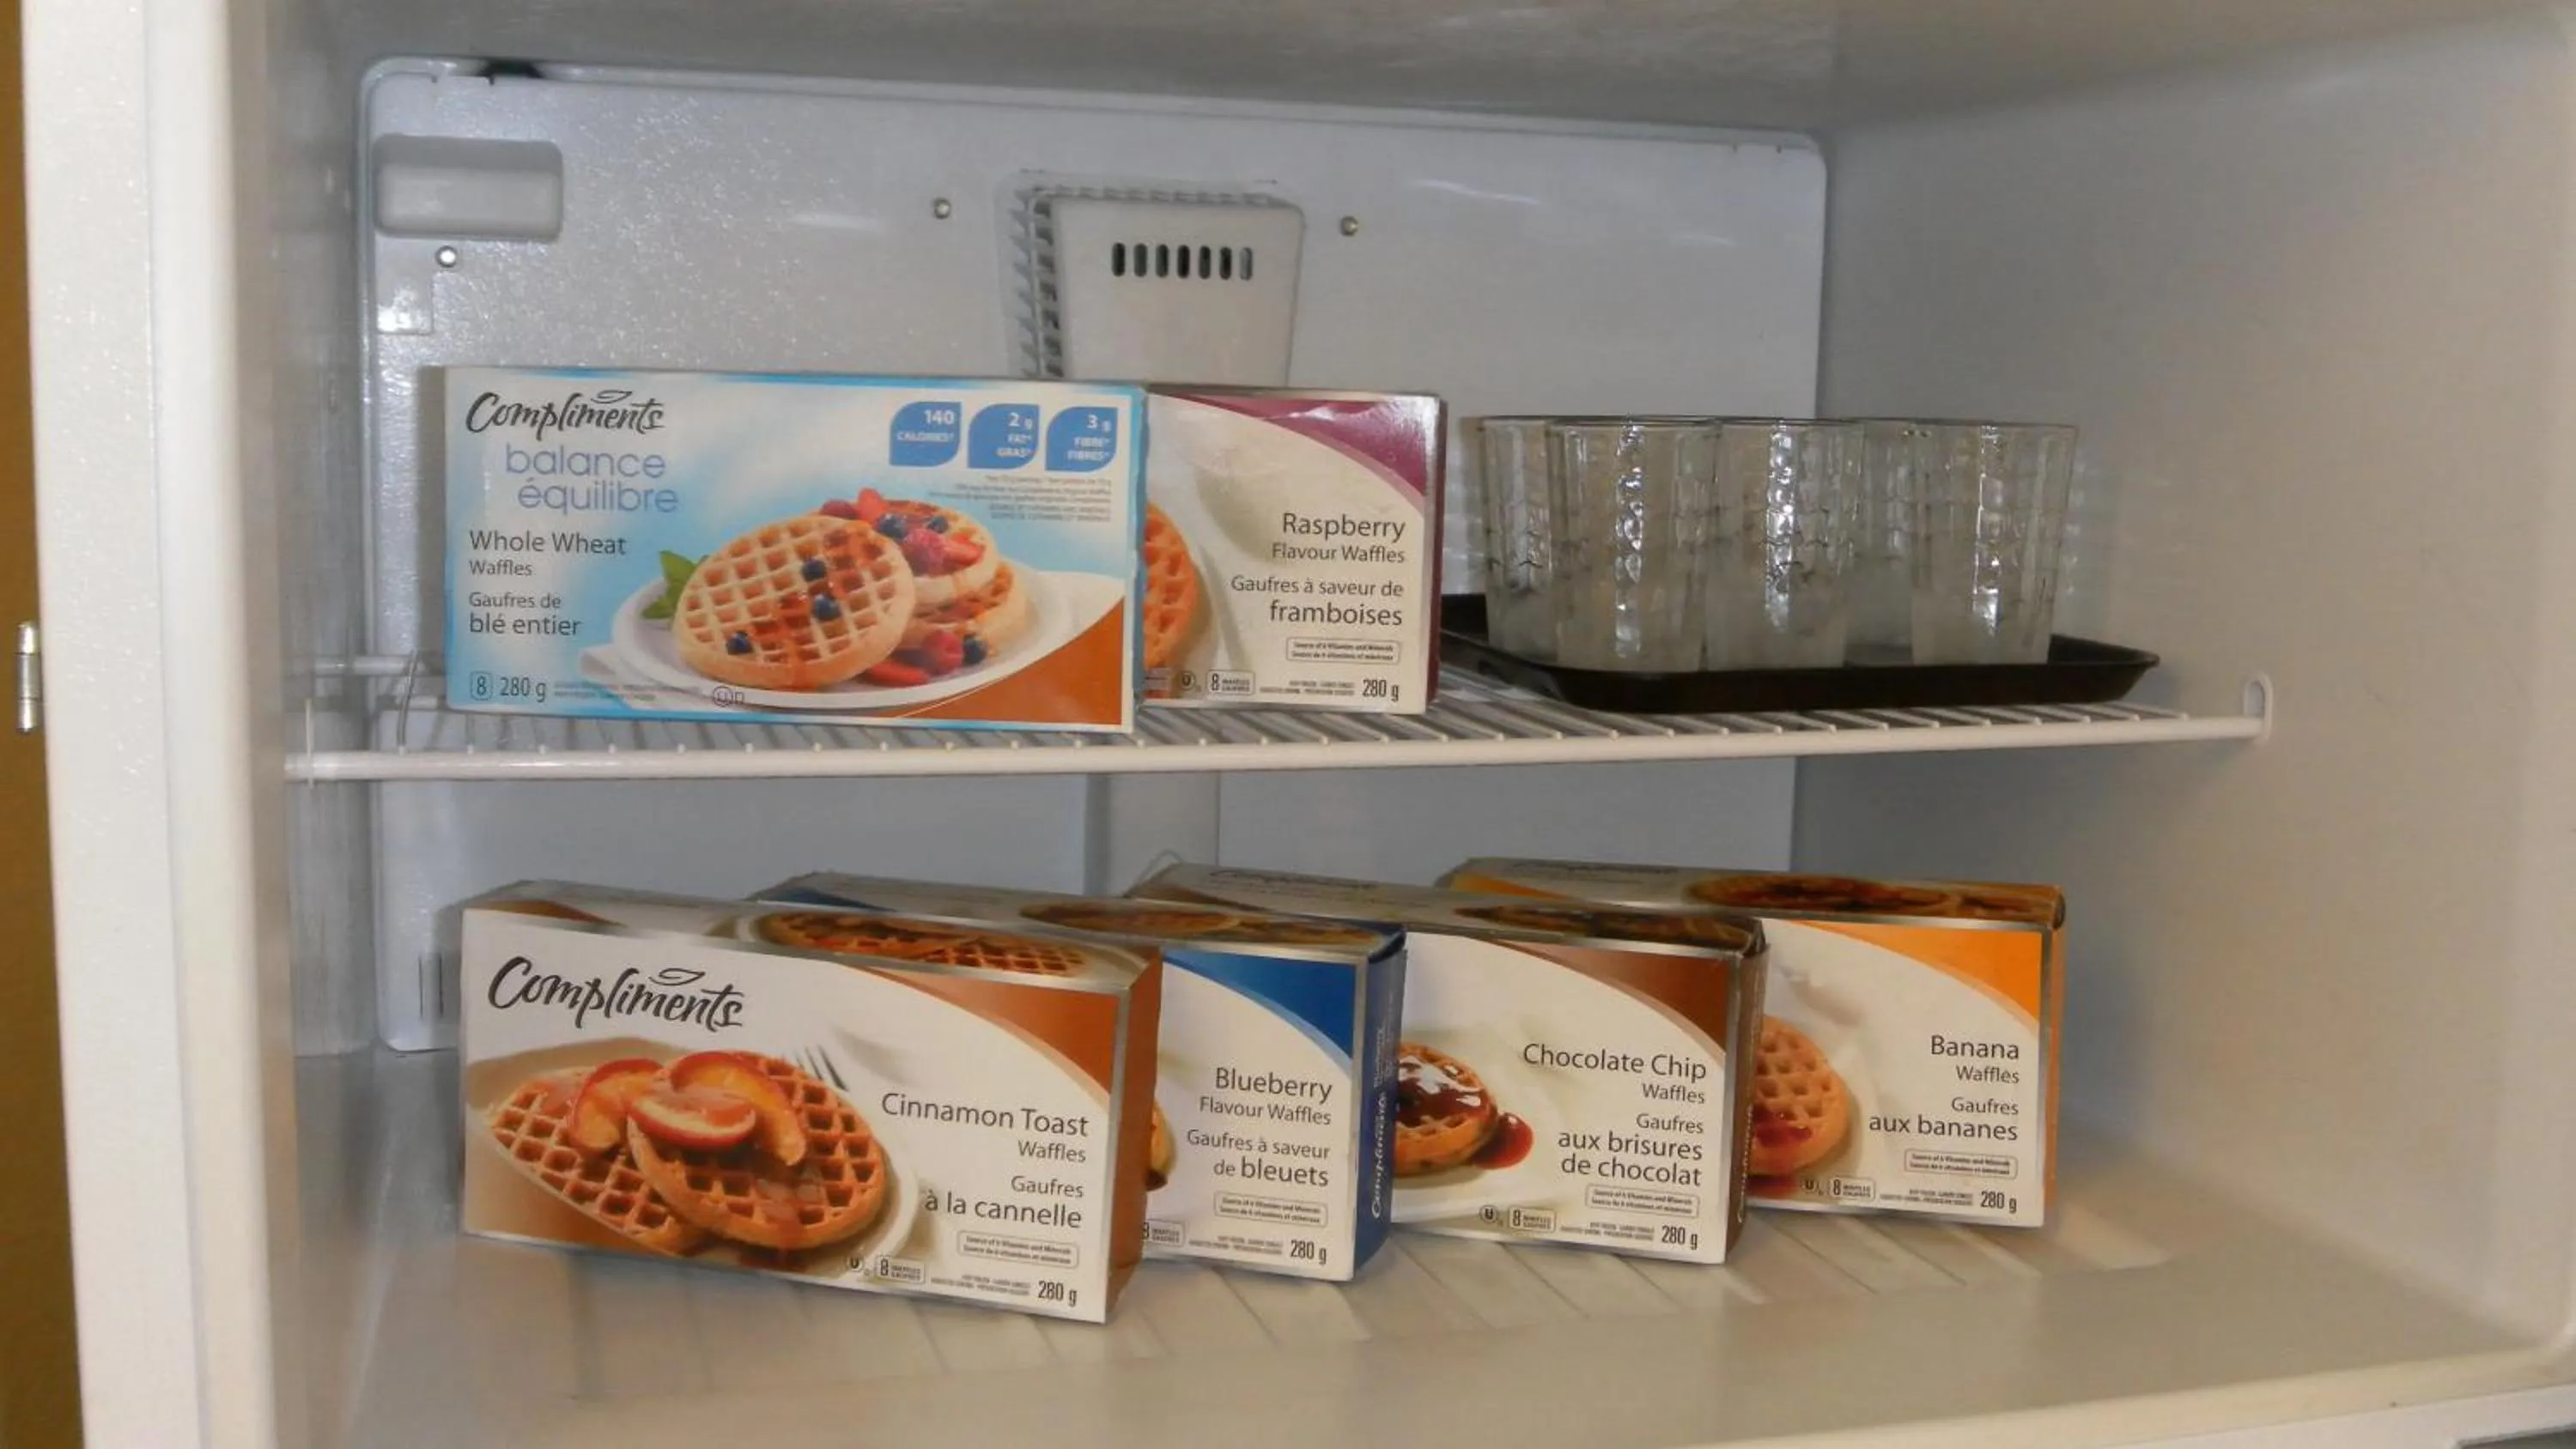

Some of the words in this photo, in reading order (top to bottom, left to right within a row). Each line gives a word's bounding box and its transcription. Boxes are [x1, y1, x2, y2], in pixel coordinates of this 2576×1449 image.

[466, 391, 665, 440] Compliments
[925, 409, 955, 424] 140
[1008, 412, 1020, 427] 2
[1086, 414, 1098, 428] 3
[505, 444, 666, 477] balance
[517, 477, 679, 514] équilibre
[1282, 512, 1406, 543] Raspberry
[469, 530, 544, 553] Whole
[551, 532, 627, 555] Wheat
[1272, 543, 1337, 561] Flavour
[1342, 545, 1405, 563] Waffles
[469, 559, 533, 577] Waffles
[1230, 574, 1300, 594] Gaufres
[1303, 577, 1314, 594] à
[1318, 581, 1376, 596] saveur
[1381, 580, 1404, 597] de
[469, 591, 535, 609] Gaufres
[540, 592, 562, 609] de
[469, 612, 507, 634] blé
[513, 615, 581, 636] entier
[1270, 600, 1403, 626] framboises
[477, 676, 487, 696] 8
[500, 676, 530, 697] 280
[535, 679, 547, 703] g
[1211, 673, 1220, 691] 8
[1363, 678, 1388, 697] 280
[1391, 683, 1400, 701] g
[488, 956, 744, 1032] Compliments
[1930, 1034, 2020, 1060] Banana
[1523, 1043, 1644, 1074] Chocolate
[1651, 1054, 1707, 1083] Chip
[1956, 1064, 2020, 1084] Waffles
[1215, 1067, 1333, 1106] Blueberry
[1642, 1082, 1705, 1105] Waffles
[881, 1093, 1014, 1129] Cinnamon
[1020, 1108, 1090, 1137] Toast
[1200, 1096, 1263, 1119] Flavour
[1268, 1104, 1332, 1126] Waffles
[1951, 1096, 2019, 1116] Gaufres
[1636, 1113, 1704, 1134] Gaufres
[1868, 1115, 1911, 1133] aux
[1917, 1114, 2019, 1141] bananes
[1018, 1140, 1086, 1163] Waffles
[1187, 1129, 1254, 1151] Gaufres
[1258, 1137, 1268, 1153] à
[1273, 1142, 1331, 1160] saveur
[1558, 1131, 1601, 1149] aux
[1608, 1131, 1703, 1161] brisures
[1213, 1160, 1235, 1178] de
[1241, 1156, 1329, 1187] bleuets
[1561, 1153, 1591, 1174] de
[1598, 1155, 1702, 1187] chocolat
[1011, 1175, 1083, 1198] Gaufres
[1832, 1179, 1842, 1196] 8
[924, 1191, 939, 1212] à
[947, 1191, 966, 1216] la
[975, 1199, 1083, 1228] cannelle
[1981, 1190, 2005, 1210] 280
[2008, 1197, 2017, 1214] g
[1512, 1209, 1521, 1228] 8
[1662, 1225, 1686, 1246] 280
[1690, 1232, 1698, 1251] g
[1290, 1239, 1315, 1260] 280
[1319, 1247, 1327, 1266] g
[880, 1258, 890, 1277] 8
[1037, 1279, 1065, 1300] 280
[1069, 1289, 1078, 1307] g
